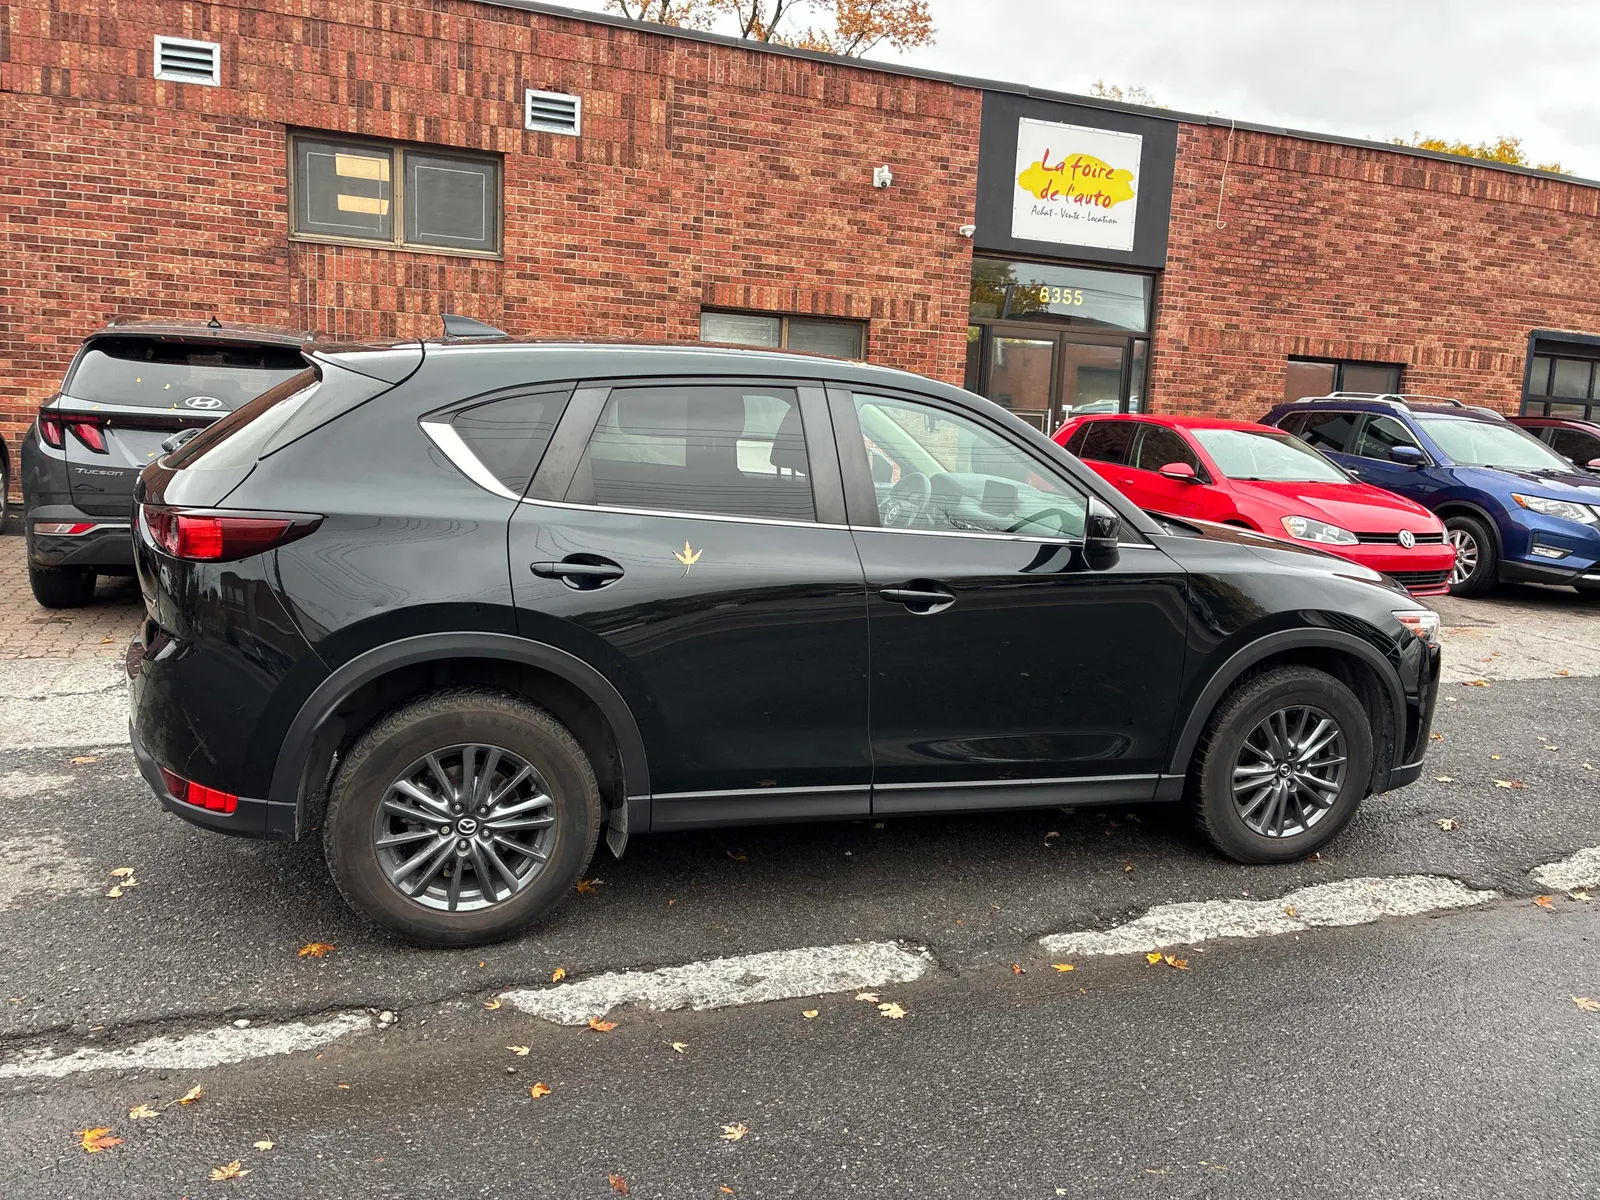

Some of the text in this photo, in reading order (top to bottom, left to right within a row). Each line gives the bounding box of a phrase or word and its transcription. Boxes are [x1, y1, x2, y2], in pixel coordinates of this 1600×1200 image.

[1042, 148, 1115, 180] La foire
[1040, 178, 1112, 208] de l'auto
[1031, 205, 1053, 216] Achat
[1060, 207, 1080, 220] Vente
[1087, 211, 1118, 224] Location
[1039, 286, 1083, 306] 8355
